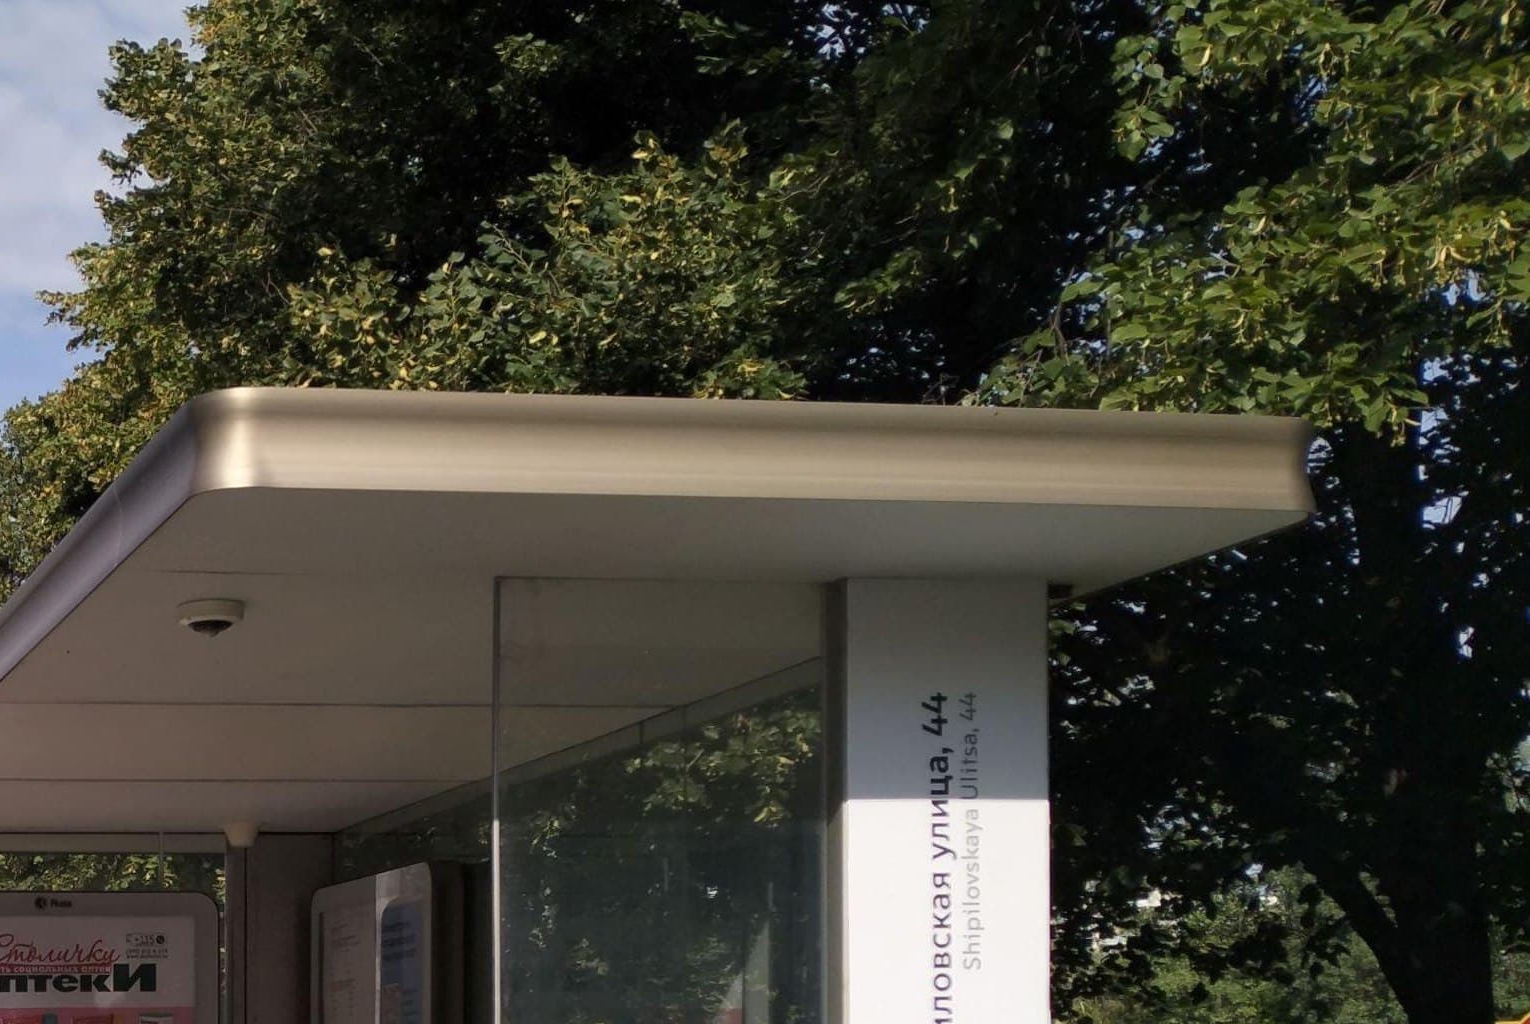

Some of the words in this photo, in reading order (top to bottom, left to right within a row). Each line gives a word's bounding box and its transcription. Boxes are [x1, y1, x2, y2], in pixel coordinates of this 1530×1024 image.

[922, 692, 949, 737] 44
[959, 692, 977, 721] 44
[960, 728, 980, 800] Ulitsa,
[930, 746, 957, 860] улица,
[961, 808, 983, 971] Shipilovskaya
